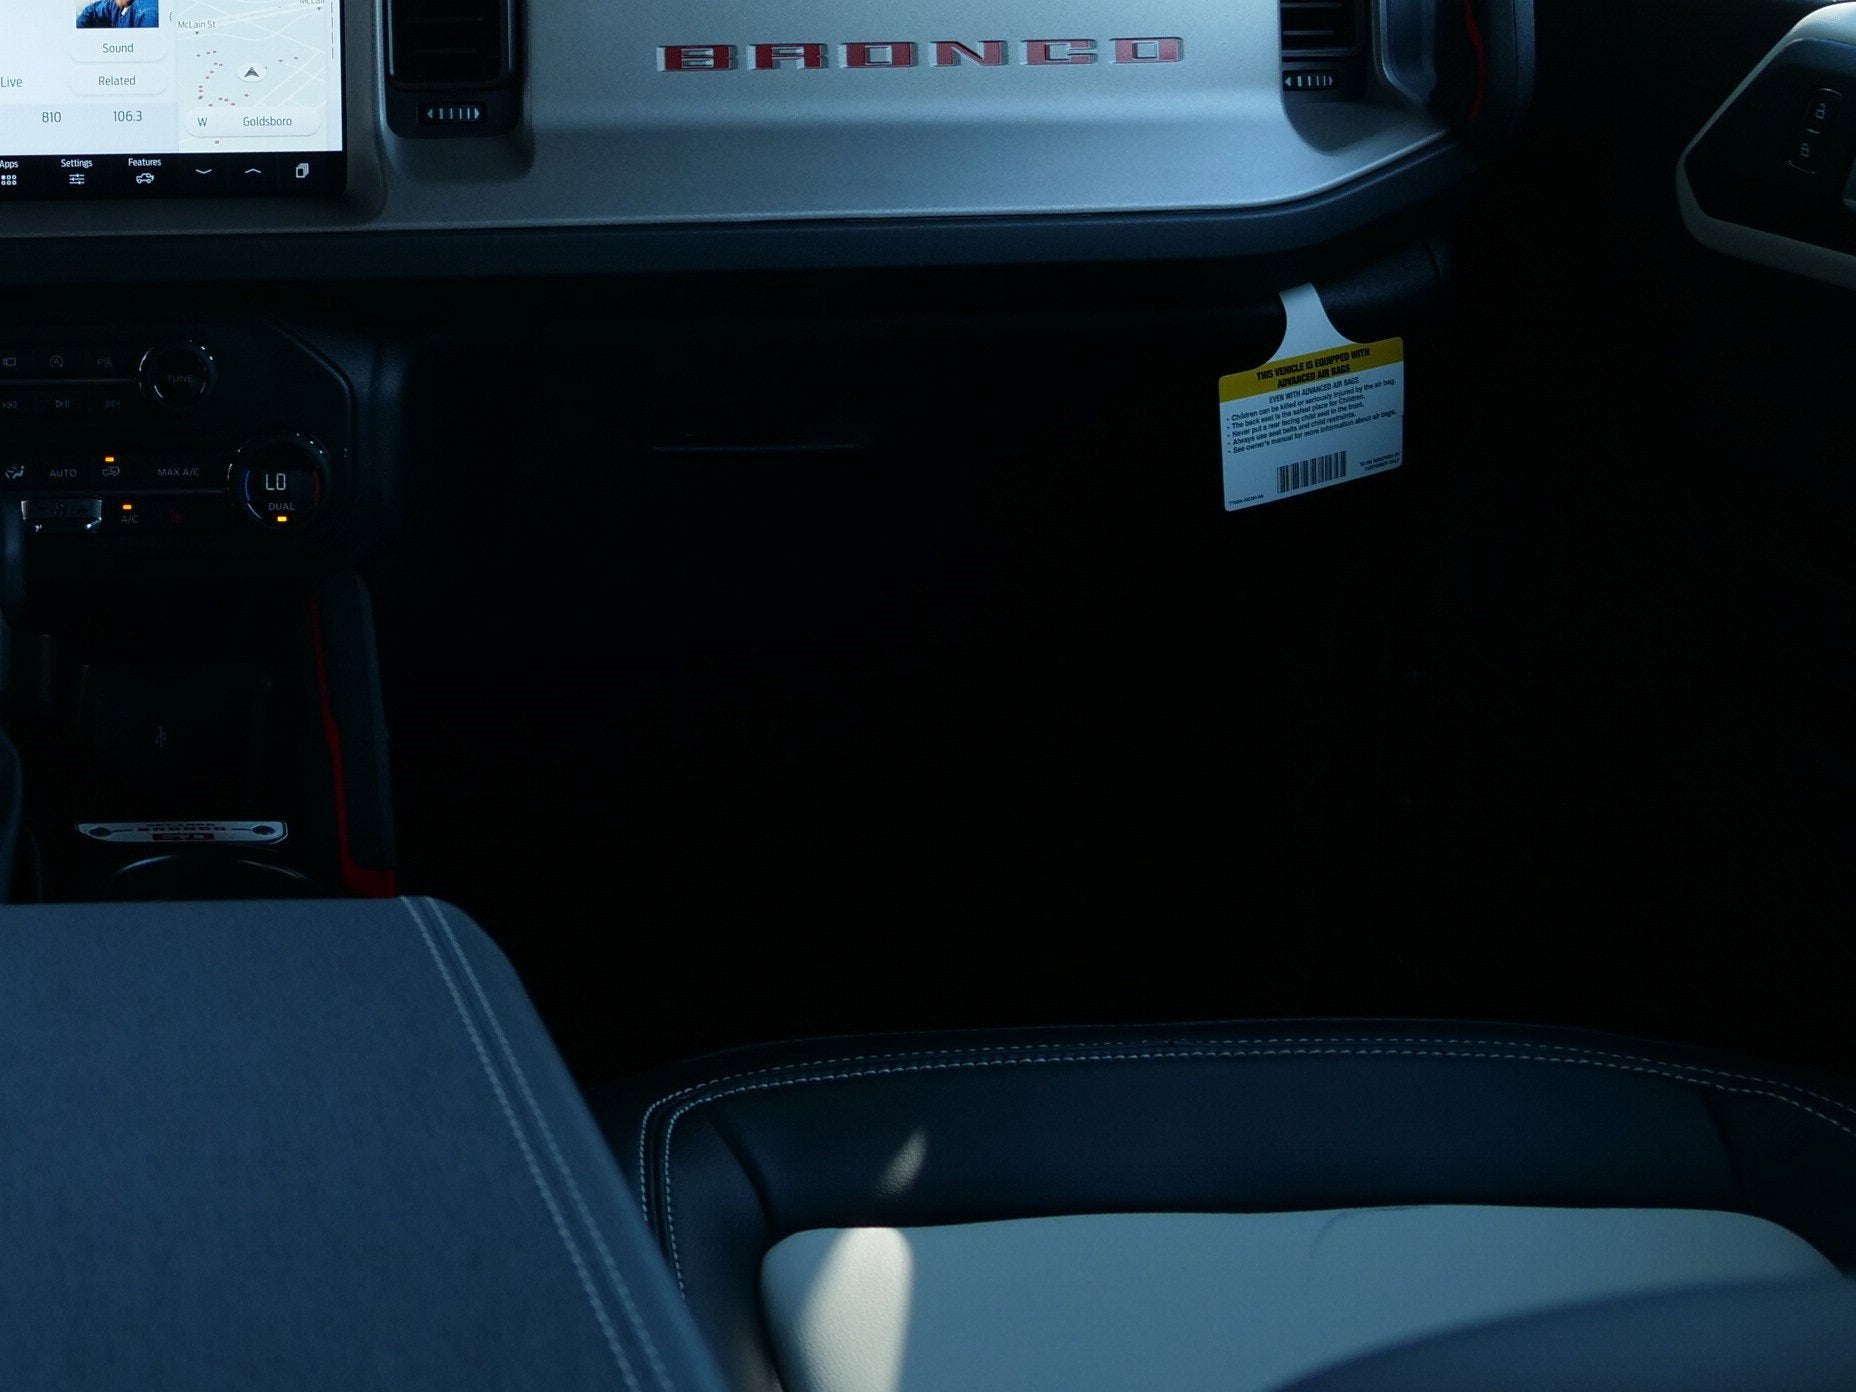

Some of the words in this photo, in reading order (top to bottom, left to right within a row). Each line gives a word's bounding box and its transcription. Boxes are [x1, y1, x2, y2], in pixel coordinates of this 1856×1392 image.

[178, 20, 206, 28] McLain
[207, 20, 216, 28] St
[102, 43, 134, 53] Sound
[657, 36, 1185, 72] BRONCO
[0, 77, 23, 88] Live
[98, 76, 136, 86] Related
[41, 112, 62, 123] 810
[113, 111, 142, 122] 106.3
[197, 118, 208, 126] W
[243, 117, 292, 126] Goldsboro
[0, 160, 19, 170] Apps
[61, 158, 93, 168] Settings
[128, 158, 161, 167] Features
[1257, 369, 1274, 381] THIS
[1275, 363, 1304, 377] VEHICLE
[1315, 352, 1349, 368] EQUIPPED
[1351, 348, 1370, 360] WITH
[168, 374, 193, 383] TUNE
[1278, 372, 1316, 388] ADVANCED
[1318, 369, 1330, 379] AIR
[1332, 364, 1351, 376] BAGS
[1269, 394, 1285, 404] EVEN
[1285, 390, 1301, 400] WITH
[1302, 383, 1332, 397] ADVANCED
[1333, 381, 1343, 389] AIR
[1344, 377, 1360, 386] BAGS
[1232, 410, 1258, 421] Children
[1280, 401, 1297, 410] killed
[1232, 421, 1244, 429] The
[1245, 418, 1260, 426] back
[1261, 415, 1274, 423] seat
[1312, 402, 1328, 412] place
[1232, 428, 1251, 437] Never
[1252, 426, 1262, 435] put
[1302, 412, 1316, 421] child
[1233, 435, 1255, 447] Always
[1269, 430, 1282, 438] seat
[1283, 426, 1298, 434] belts
[1311, 419, 1326, 427] child
[1233, 445, 1245, 454] See
[1355, 415, 1372, 424] about
[49, 468, 77, 478] AUTO
[157, 467, 181, 477] MAX
[183, 466, 200, 477] A/C
[265, 473, 287, 491] LO
[268, 501, 295, 511] DUAL
[121, 515, 138, 525] A/C
